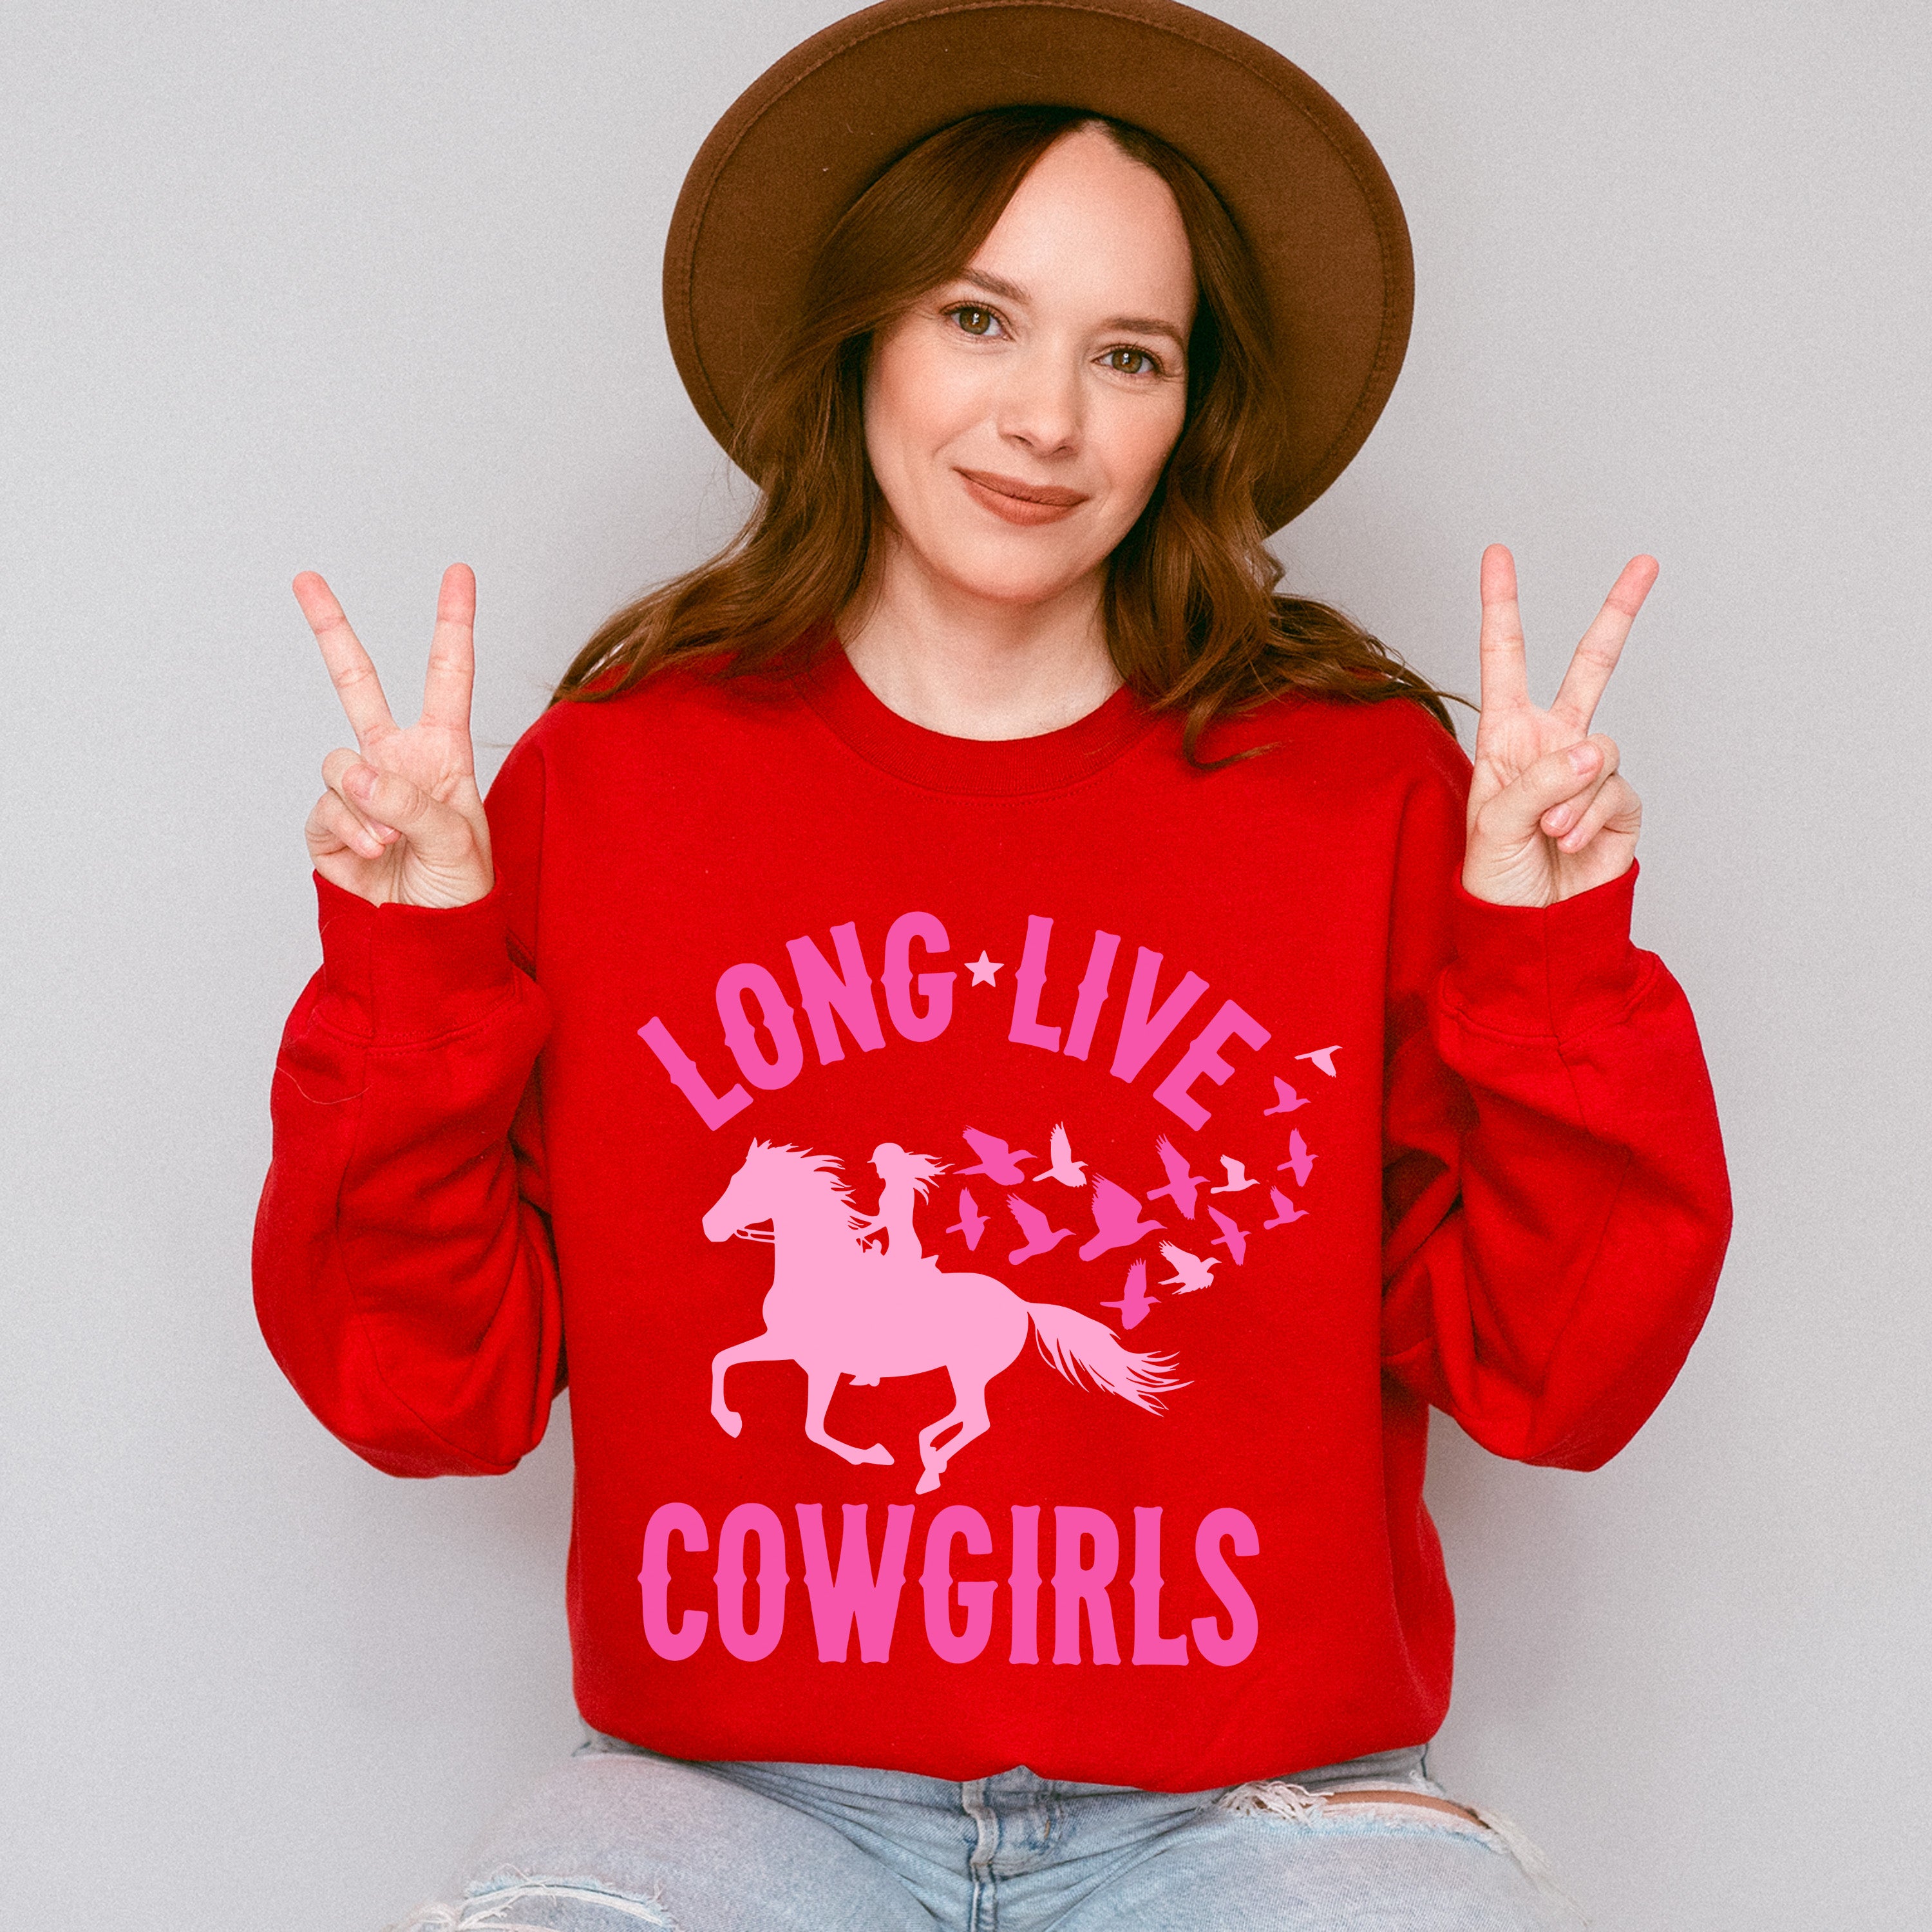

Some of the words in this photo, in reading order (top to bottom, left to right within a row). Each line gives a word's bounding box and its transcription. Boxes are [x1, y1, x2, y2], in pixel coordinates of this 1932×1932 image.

[637, 911, 957, 1132] LONG
[1008, 914, 1272, 1132] LIVE
[637, 1502, 1260, 1667] COWGIRLS
